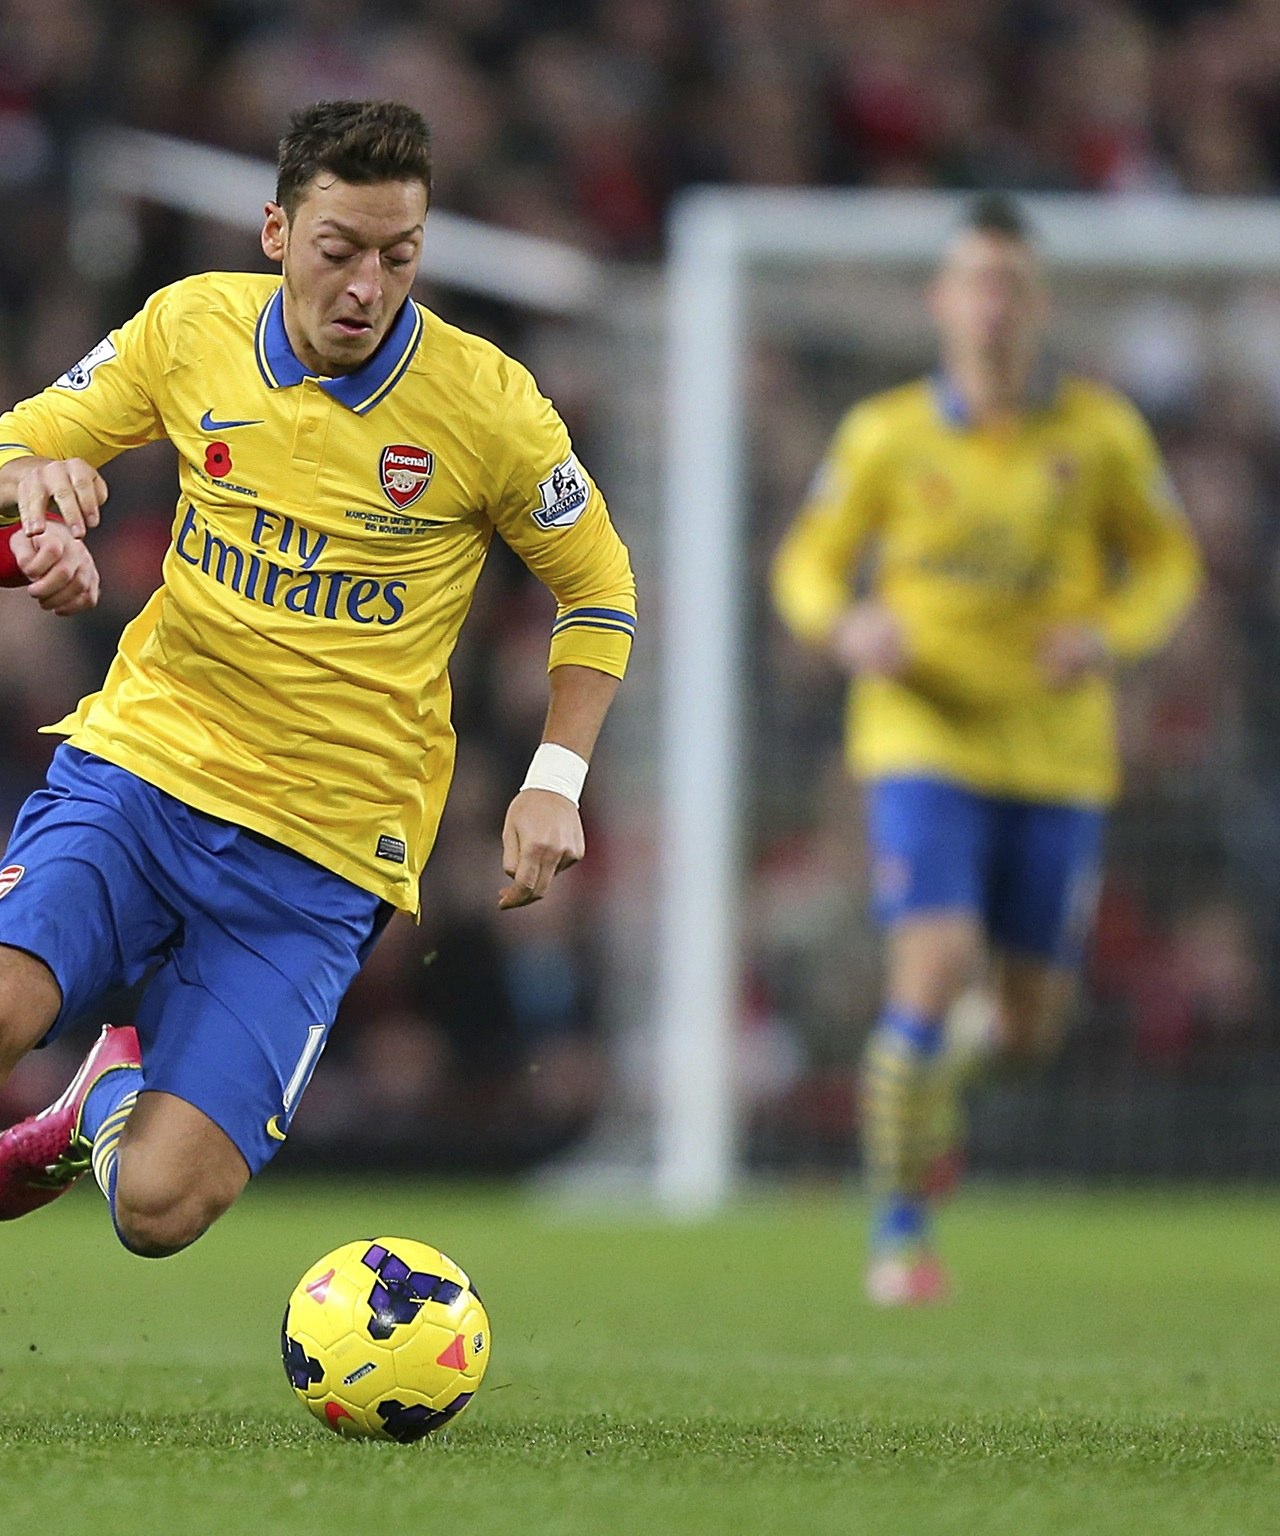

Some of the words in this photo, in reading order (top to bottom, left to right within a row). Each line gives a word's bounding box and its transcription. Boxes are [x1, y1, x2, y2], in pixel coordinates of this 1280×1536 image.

[386, 452, 427, 467] Arsenal
[175, 504, 408, 625] Emirates
[250, 506, 329, 569] Fly
